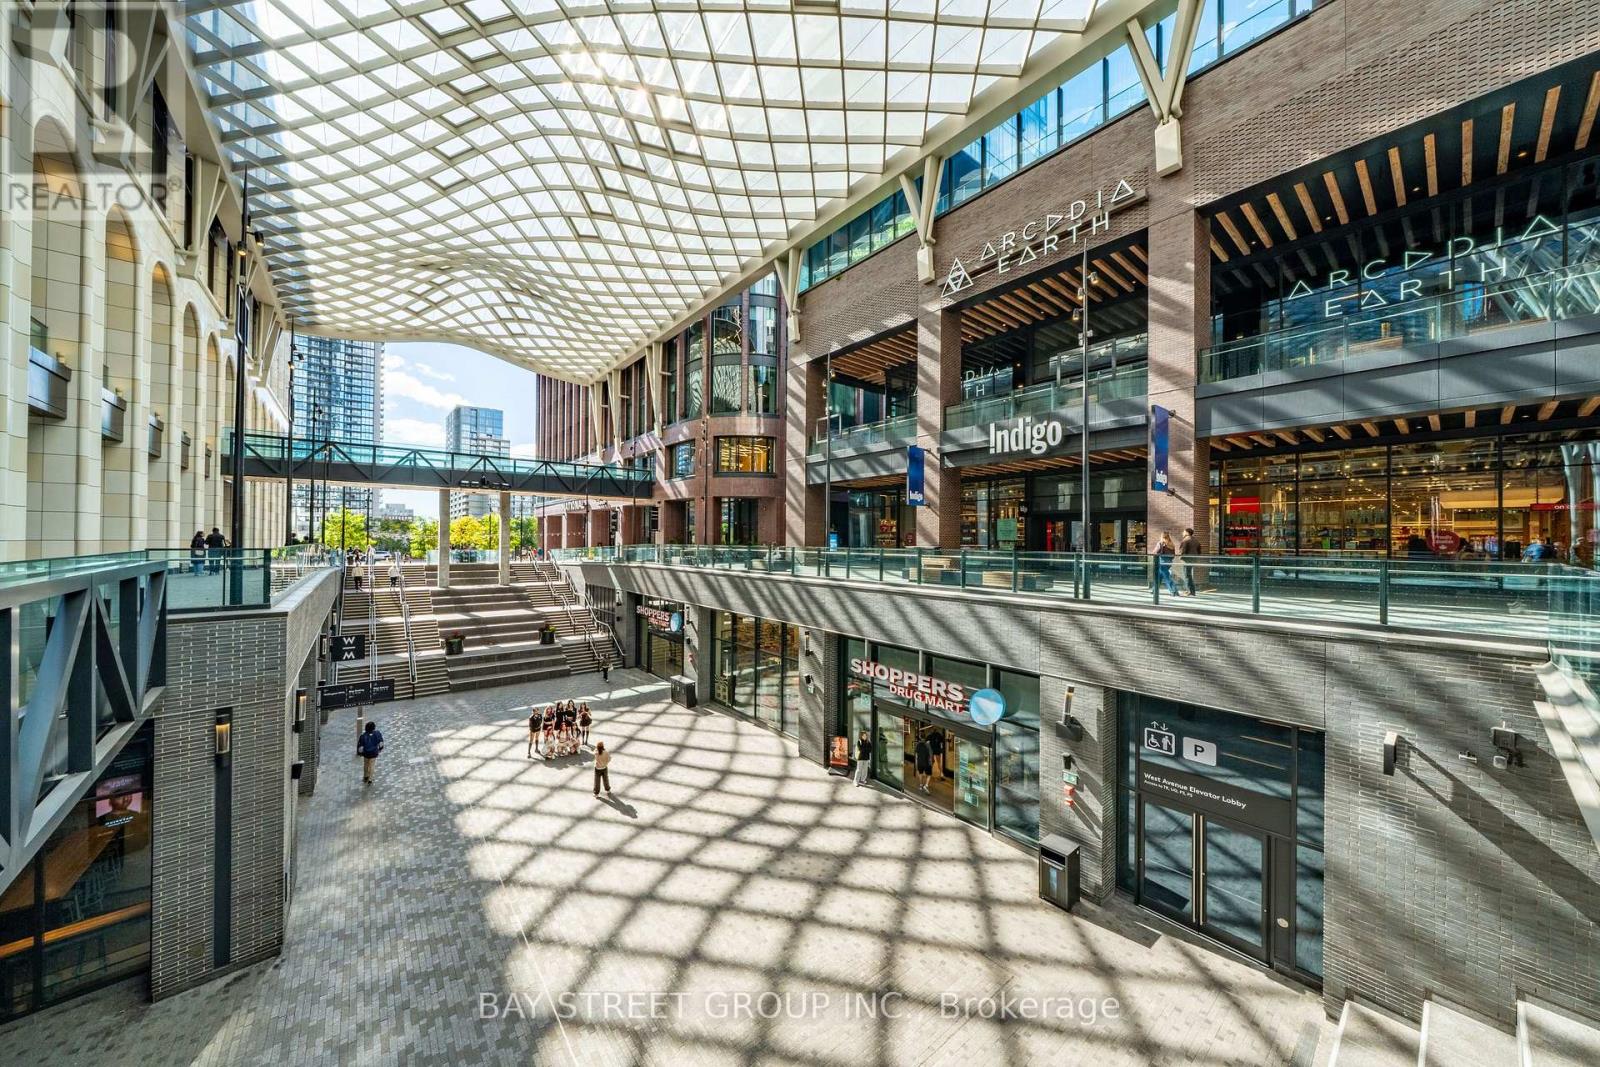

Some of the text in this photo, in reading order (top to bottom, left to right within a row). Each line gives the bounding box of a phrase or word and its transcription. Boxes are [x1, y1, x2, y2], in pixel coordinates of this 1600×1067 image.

[981, 179, 1135, 261] ARCADIA
[998, 211, 1109, 274] EARTH
[1288, 215, 1560, 300] ARCADIA
[1325, 257, 1507, 318] EARTH
[636, 605, 670, 622] SHOPPERS
[342, 636, 356, 645] W
[850, 658, 965, 702] SHOPPERS
[1194, 744, 1205, 757] P
[1144, 772, 1161, 783] West
[1162, 778, 1188, 790] Avenue
[1189, 786, 1221, 800] Elevator
[1222, 795, 1247, 810] Lobby
